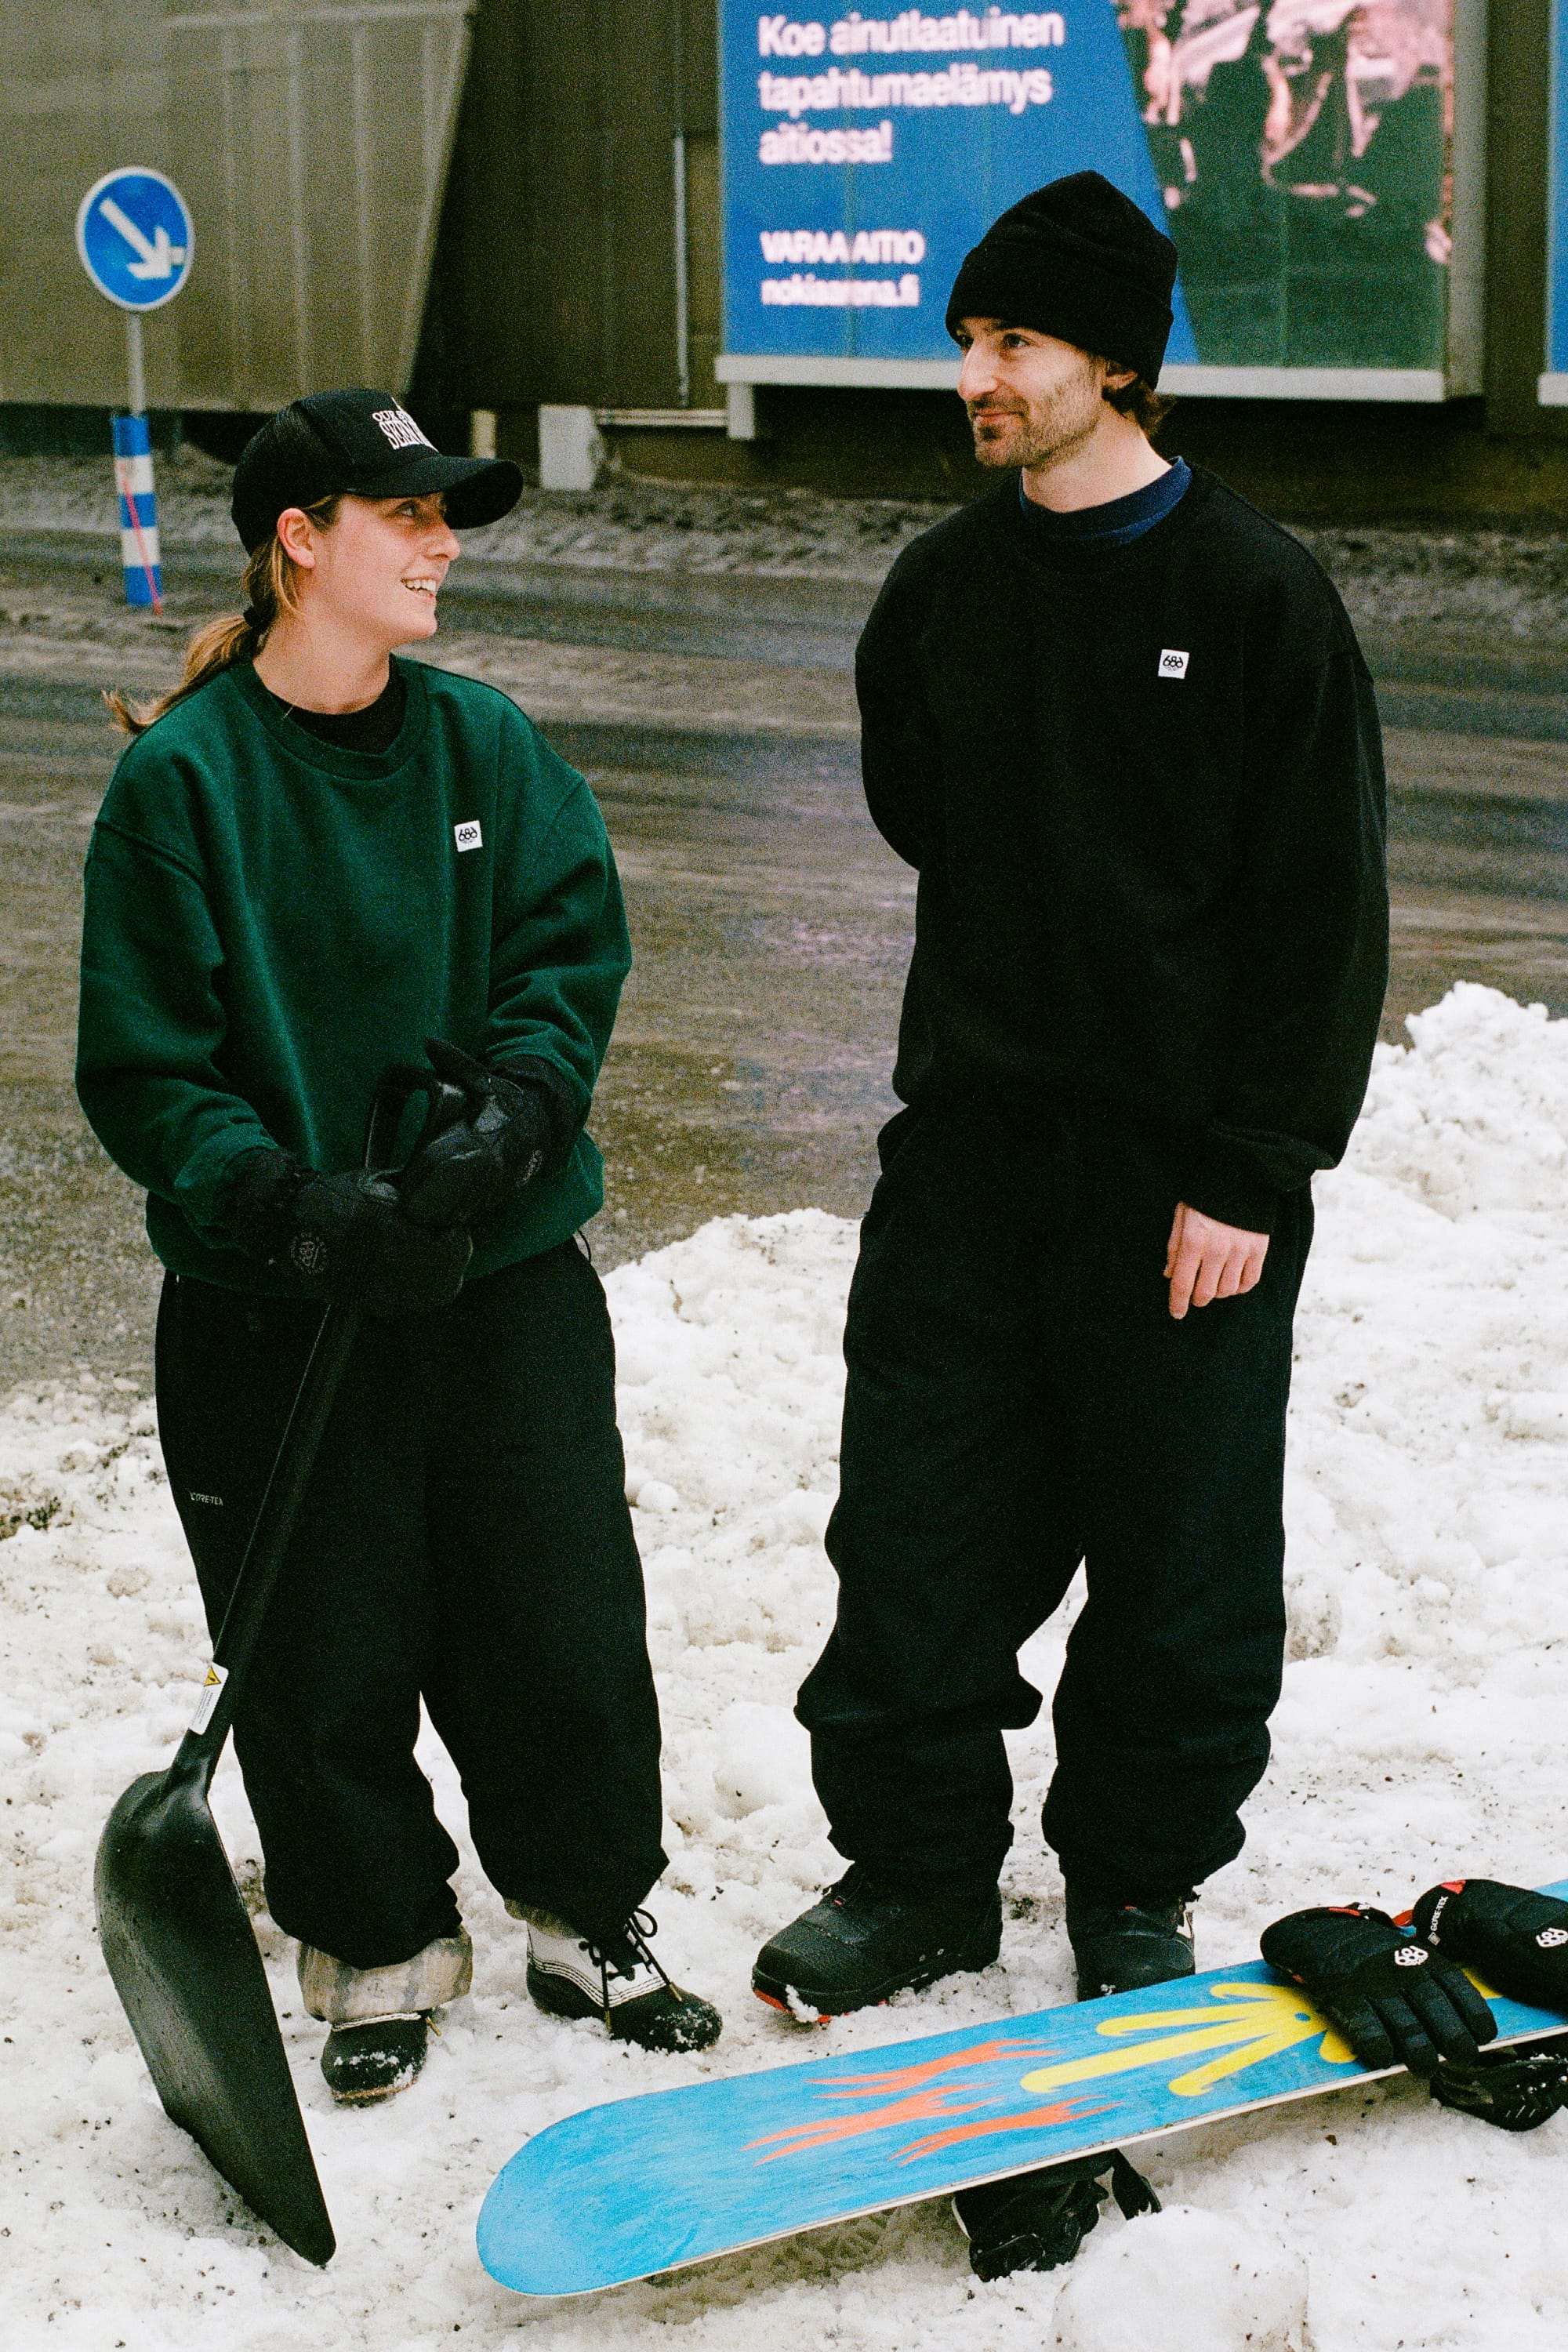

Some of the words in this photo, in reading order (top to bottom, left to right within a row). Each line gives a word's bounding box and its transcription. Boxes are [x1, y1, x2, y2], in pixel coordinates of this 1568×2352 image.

[760, 16, 825, 55] Koe
[830, 8, 1063, 53] ainutlaatuinen
[760, 64, 1052, 117] tapahtumaelämys
[760, 231, 849, 263] VARAA
[852, 231, 924, 263] AITIO
[1163, 655, 1184, 669] 686
[458, 826, 477, 841] 686
[1430, 1896, 1449, 1932] GORE-TEX
